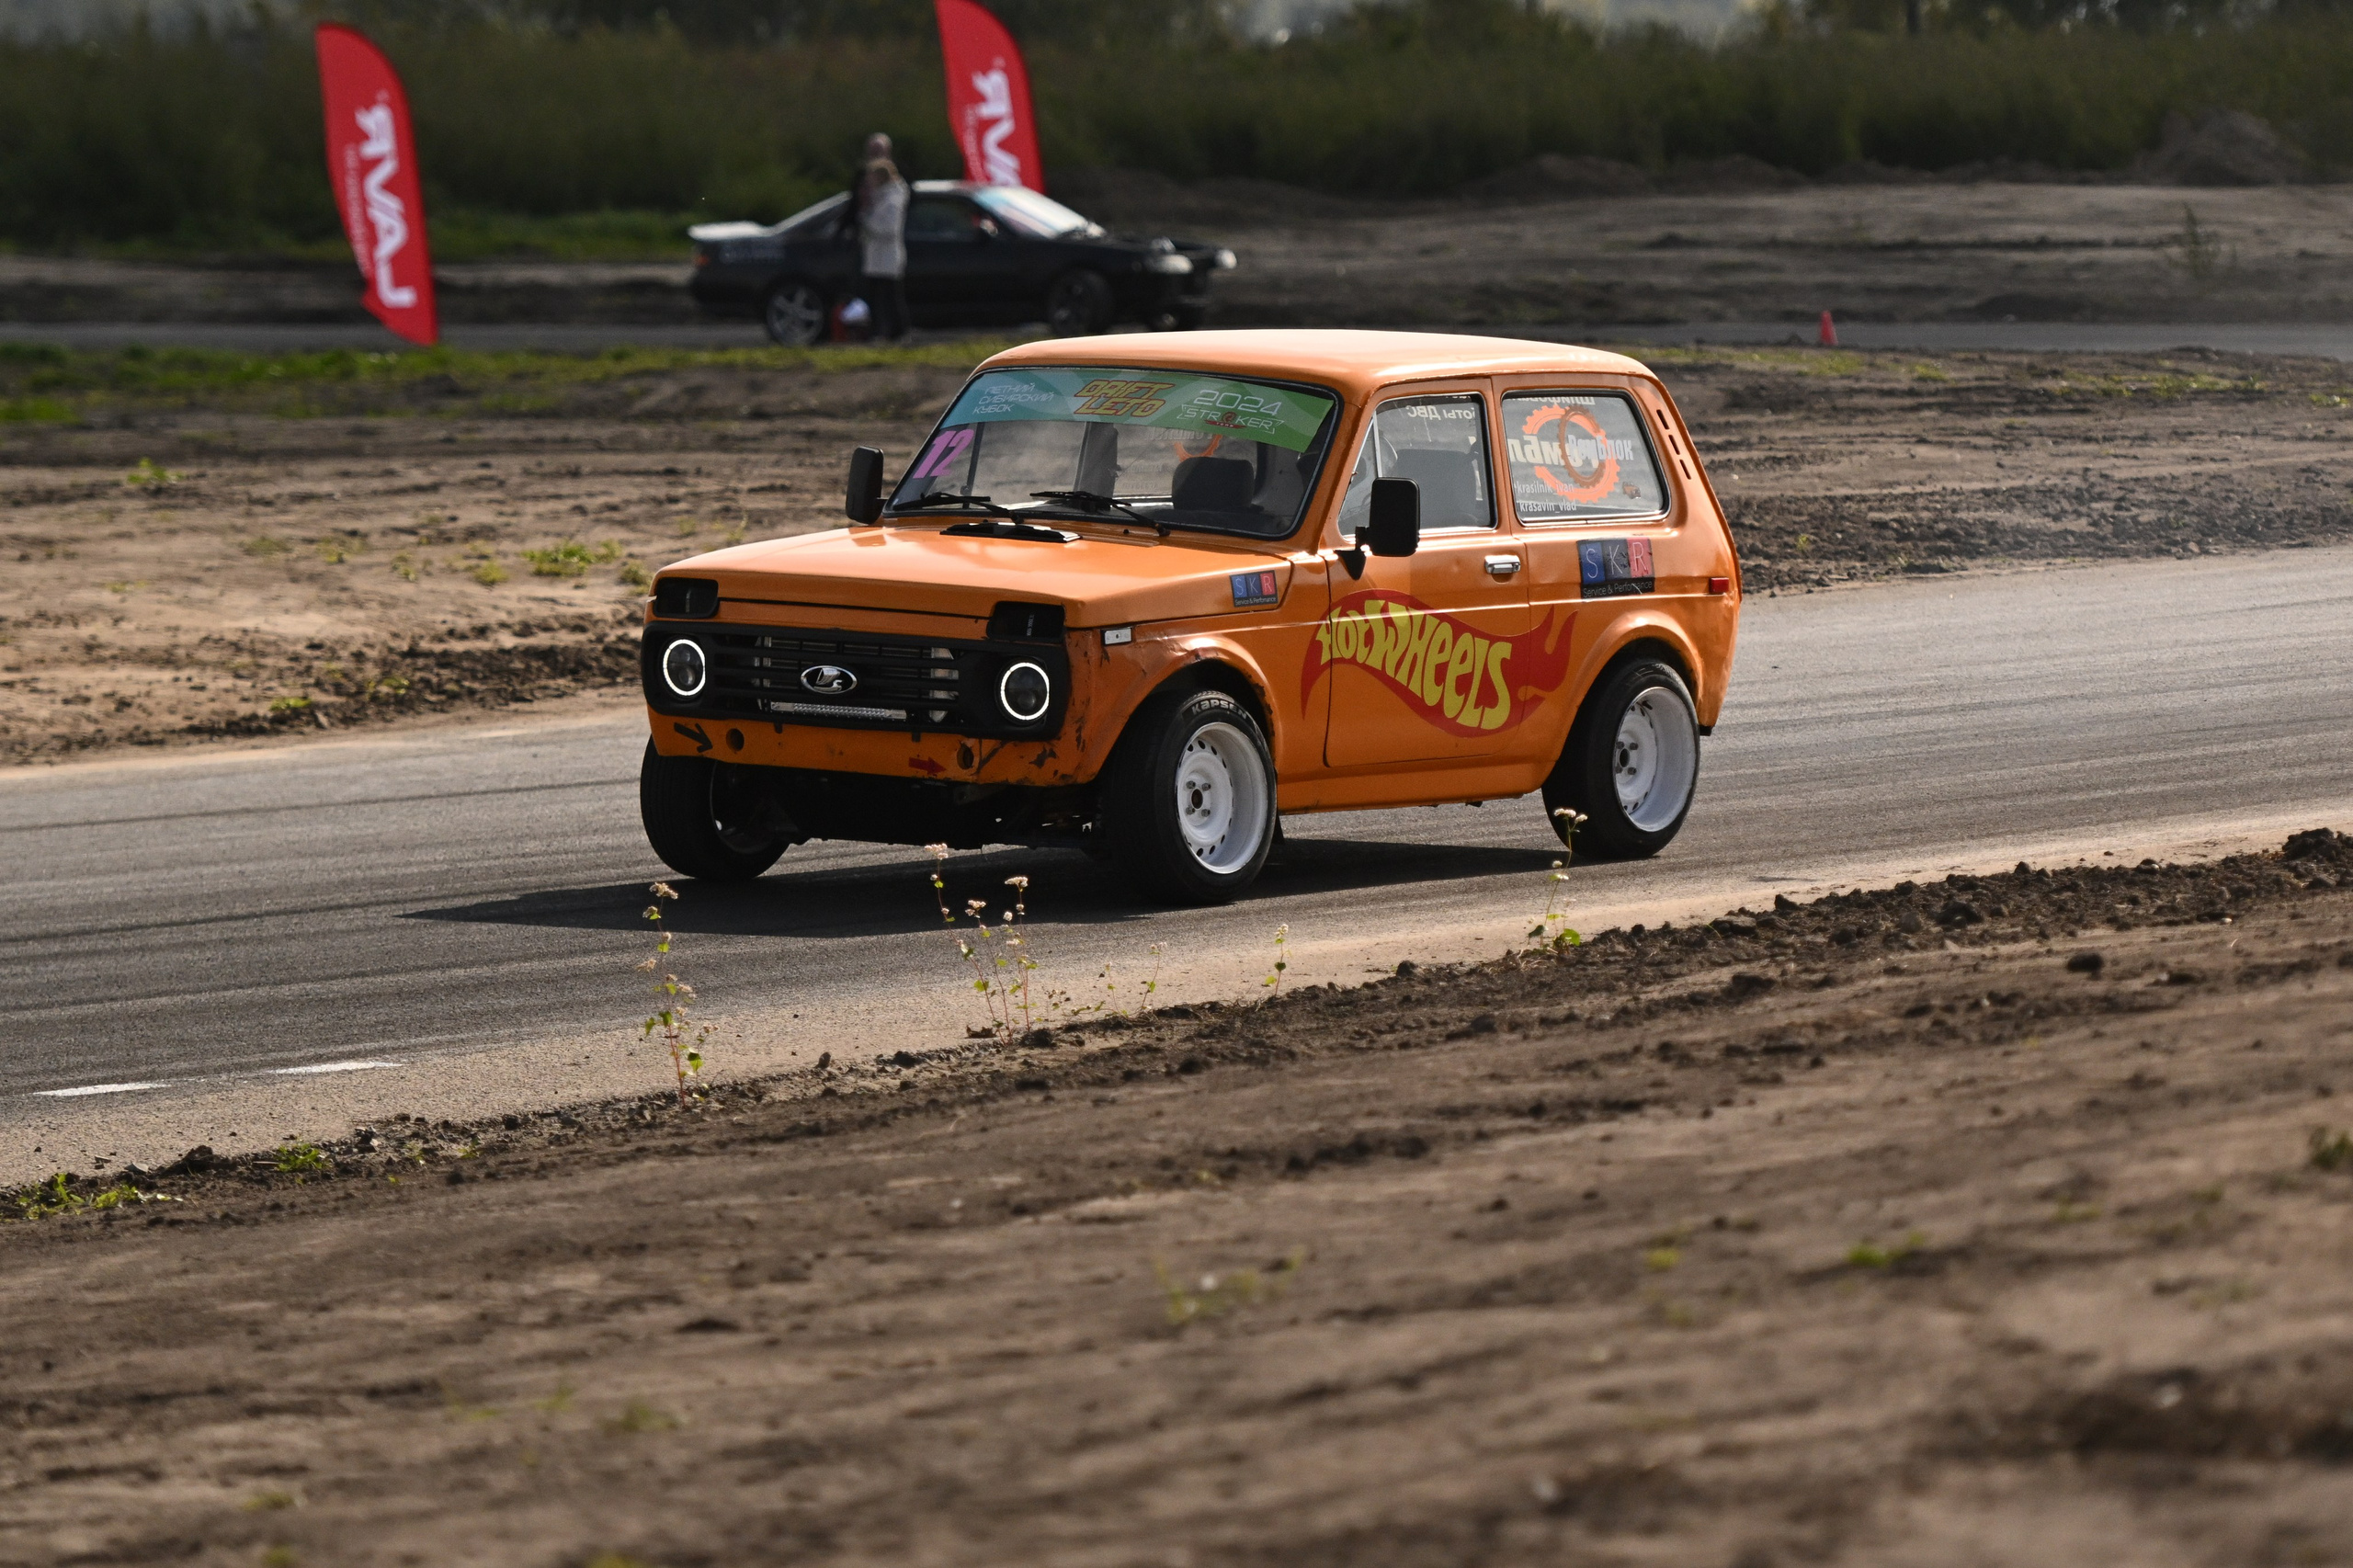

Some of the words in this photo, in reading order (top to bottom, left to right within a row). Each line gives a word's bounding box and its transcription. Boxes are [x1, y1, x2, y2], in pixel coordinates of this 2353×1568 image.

[978, 392, 1055, 404] СИБИРСКИЙ
[1074, 379, 1175, 399] DRIFT
[972, 404, 1014, 415] КУБОК
[1074, 396, 1166, 418] LETO
[1193, 389, 1282, 416] 2024
[913, 428, 974, 479] 12
[1235, 575, 1273, 596] SKR
